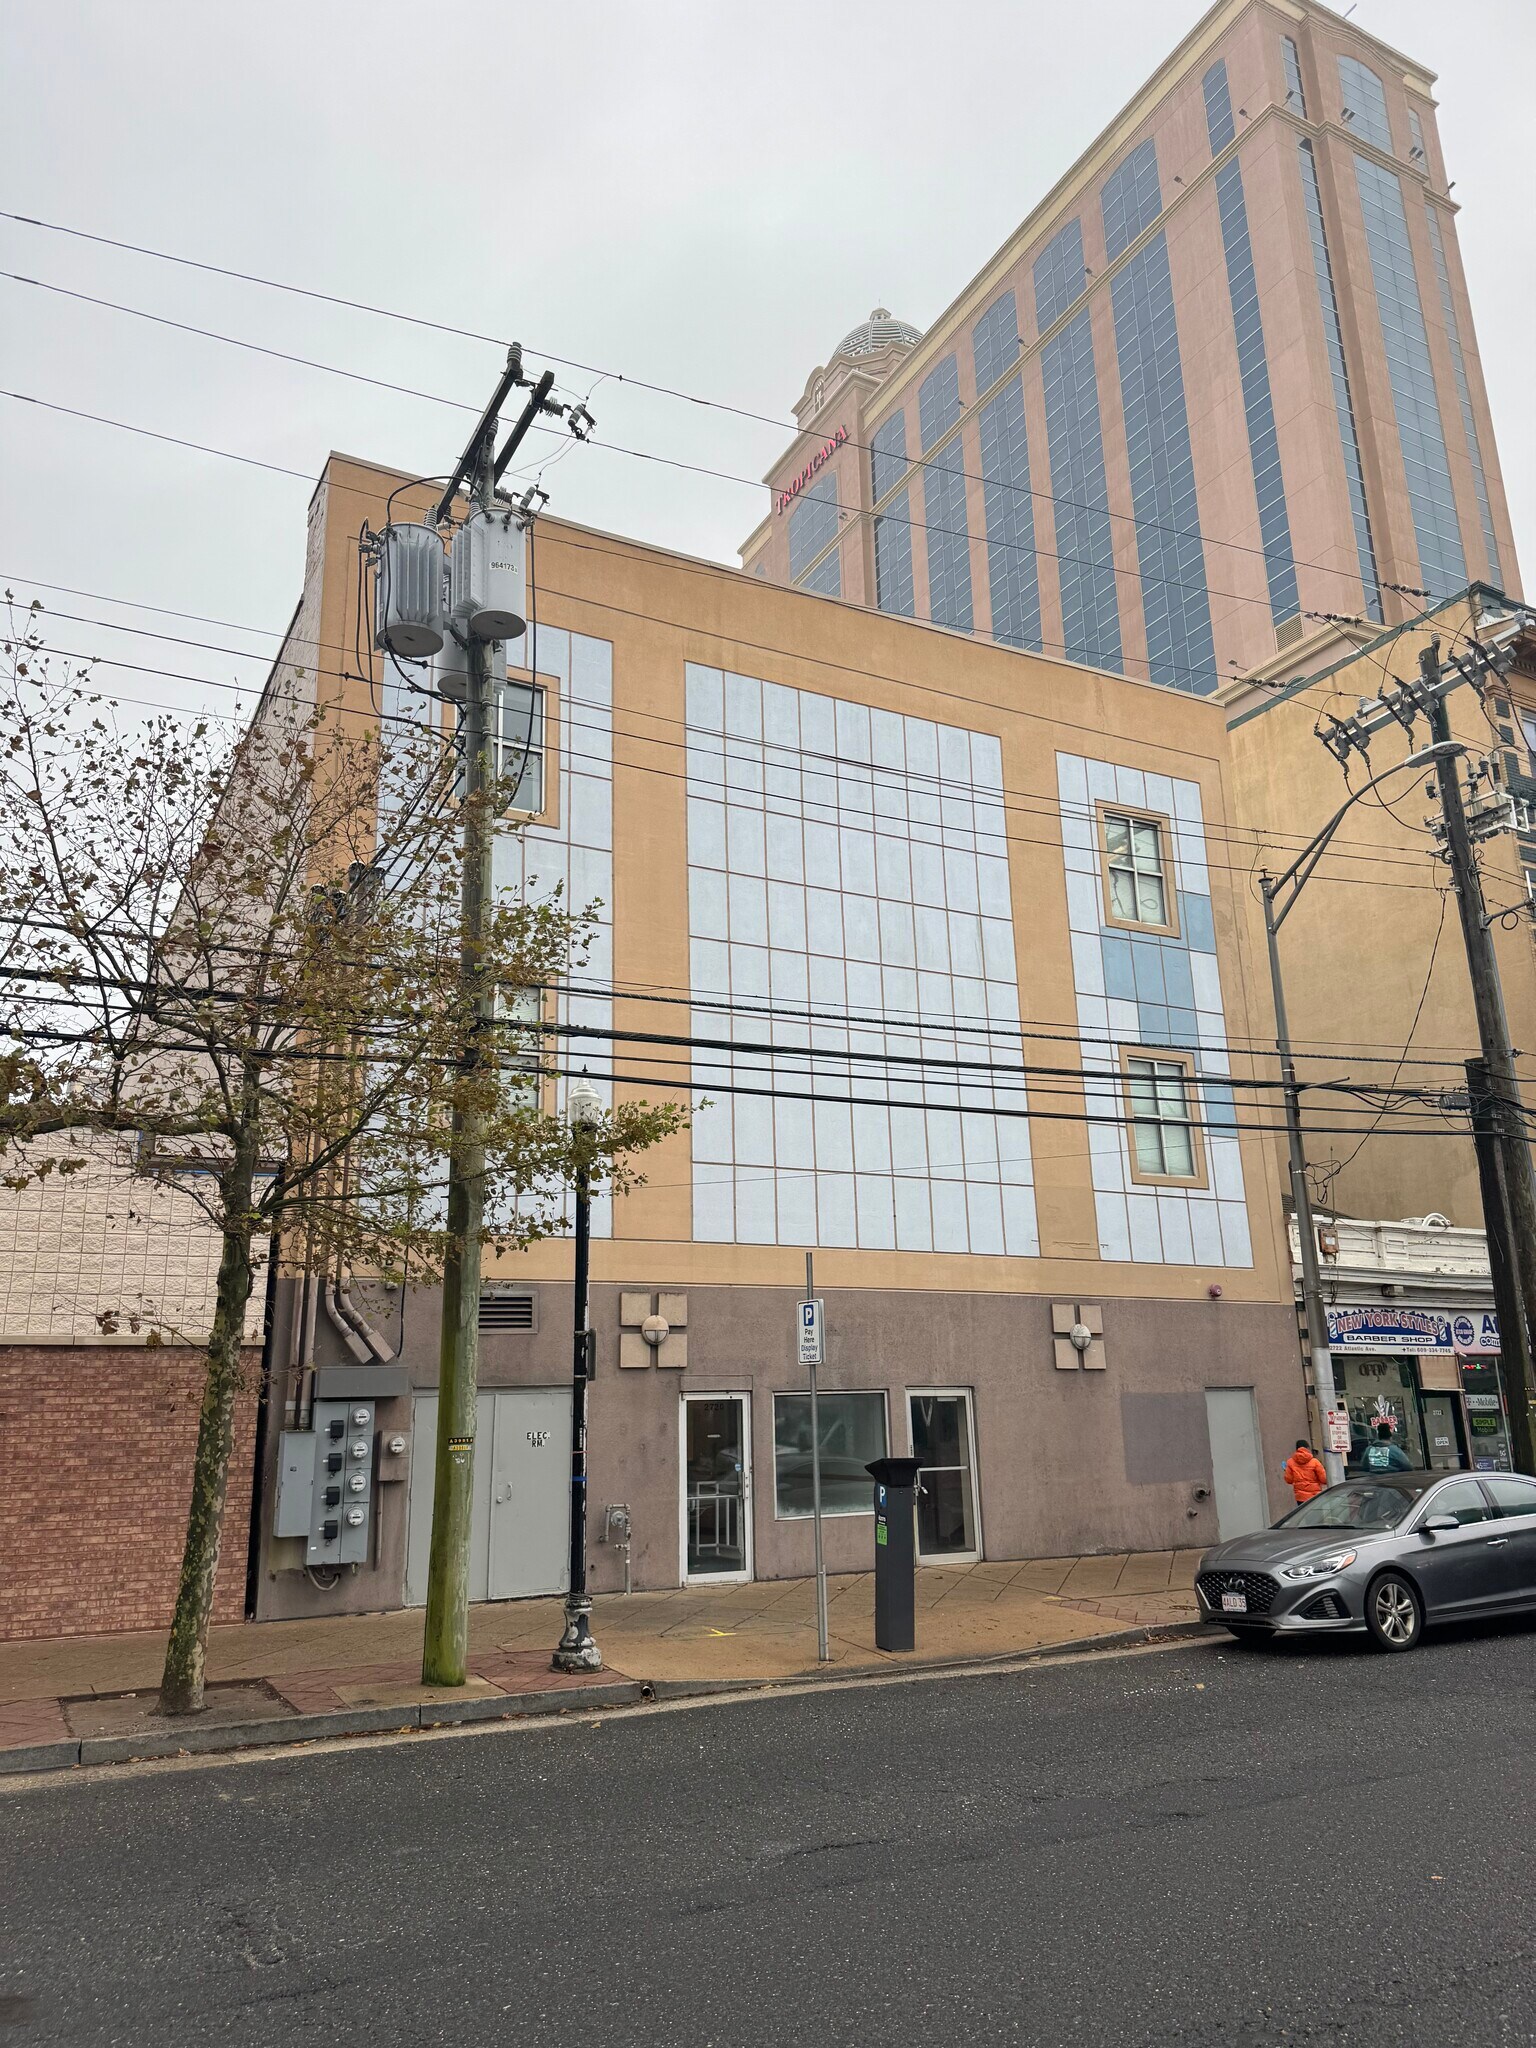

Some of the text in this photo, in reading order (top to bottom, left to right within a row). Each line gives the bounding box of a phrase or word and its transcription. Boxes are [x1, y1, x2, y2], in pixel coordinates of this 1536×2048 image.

[775, 424, 850, 516] TROPICANA
[805, 1307, 813, 1324] P
[1337, 1314, 1362, 1334] NEW
[1365, 1311, 1399, 1328] YORK
[1401, 1313, 1439, 1336] STYLES
[804, 1328, 813, 1336] Pay
[1346, 1335, 1397, 1343] BARBER
[801, 1344, 818, 1352] Display
[526, 1431, 550, 1440] ELEC.
[531, 1440, 545, 1448] RM.
